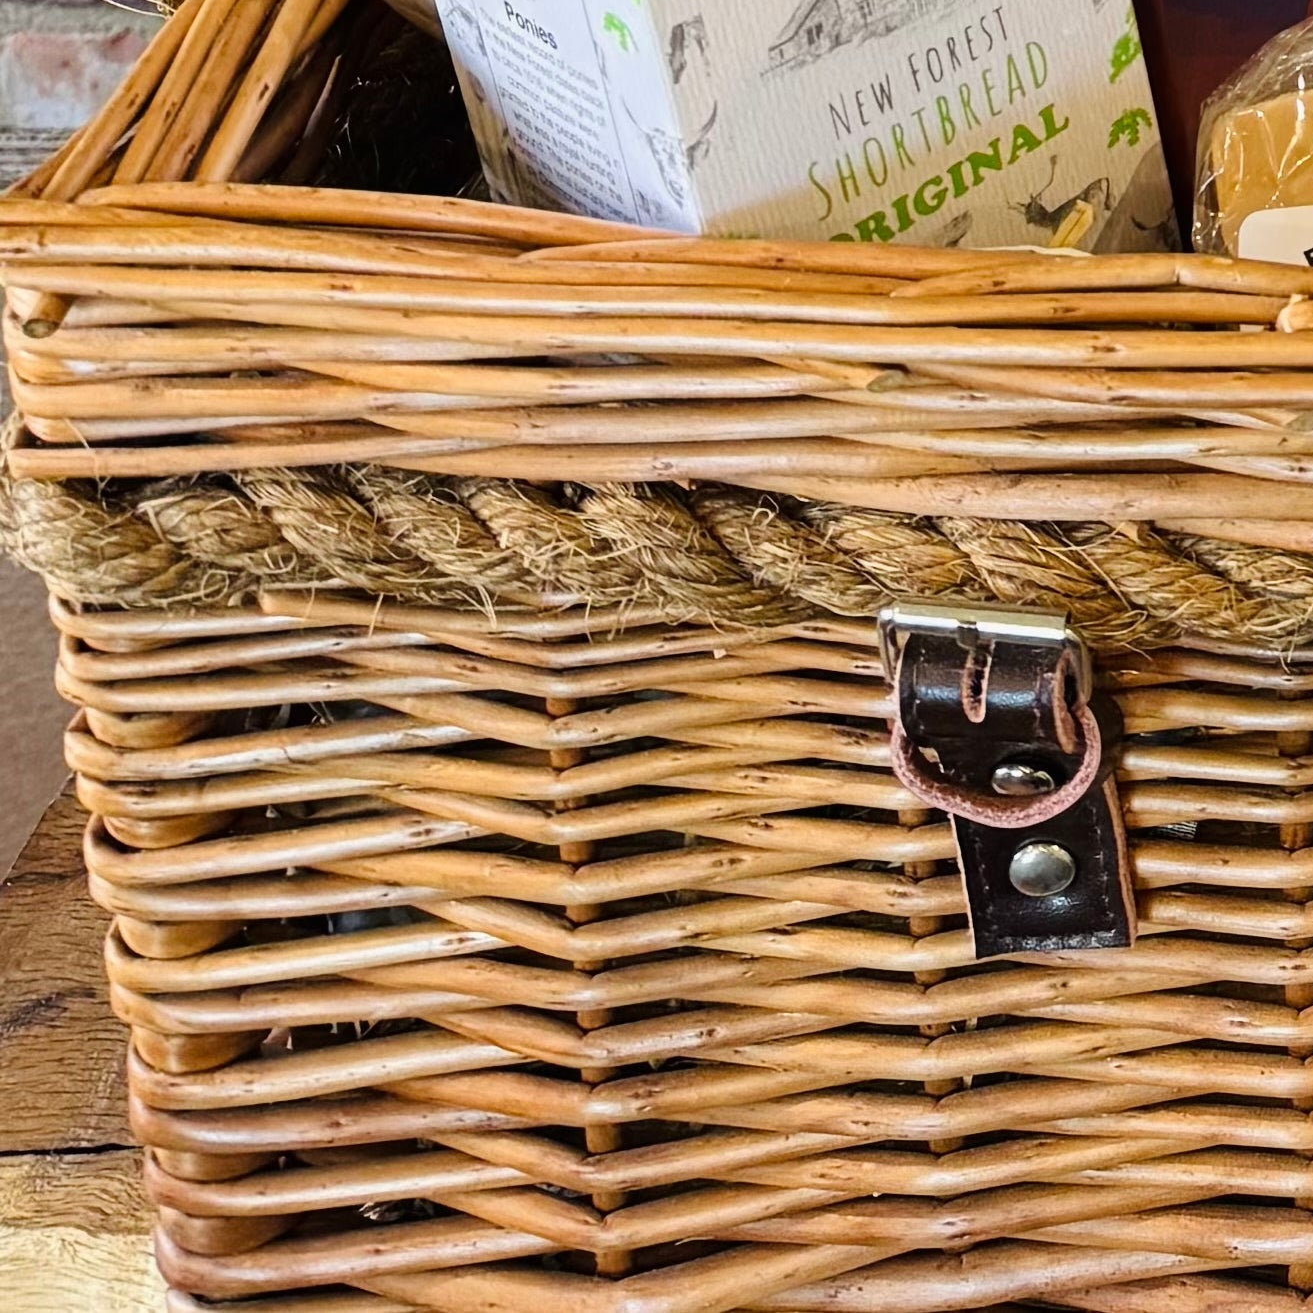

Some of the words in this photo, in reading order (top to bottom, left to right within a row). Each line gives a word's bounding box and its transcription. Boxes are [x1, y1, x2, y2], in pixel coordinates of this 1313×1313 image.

[807, 41, 1050, 222] SHORTBREAD
[829, 74, 896, 141] NEW
[908, 6, 1010, 95] FOREST
